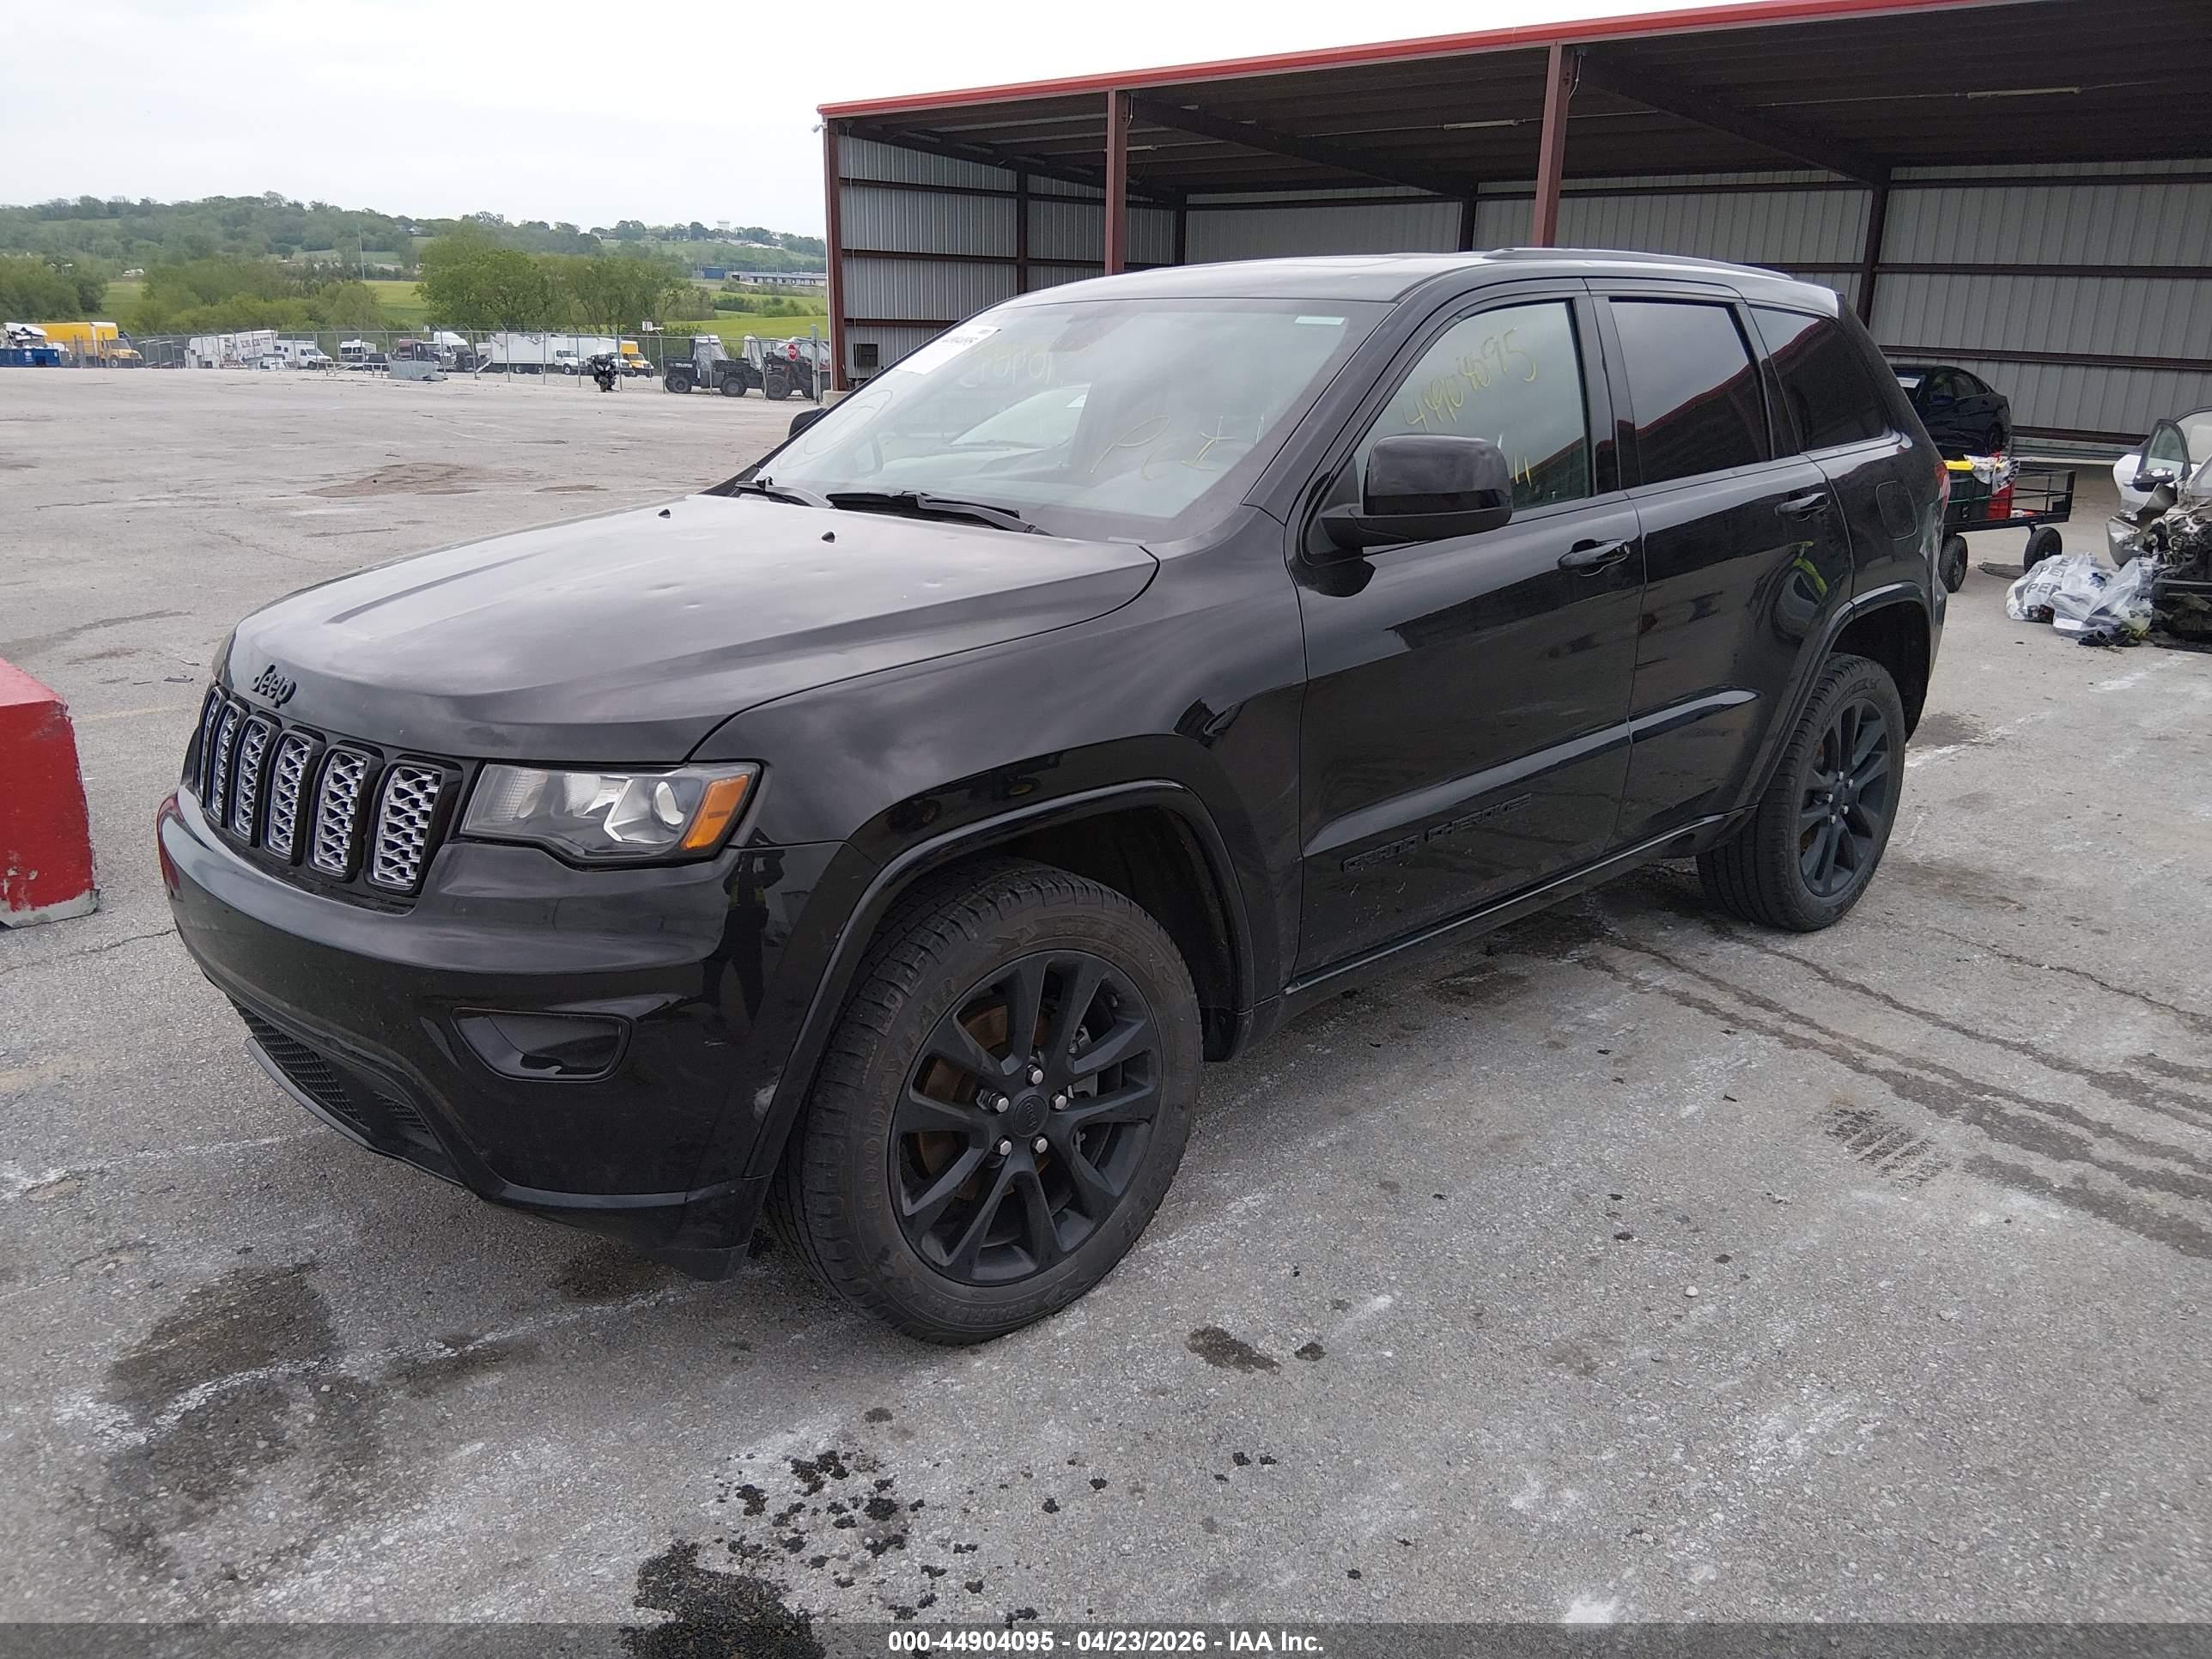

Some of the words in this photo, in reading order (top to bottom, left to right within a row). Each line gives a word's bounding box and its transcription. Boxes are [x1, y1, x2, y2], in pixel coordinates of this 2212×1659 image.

[251, 664, 297, 709] Jeep
[1340, 835, 1419, 872] GRAND
[1424, 792, 1533, 842] CHEROKEE
